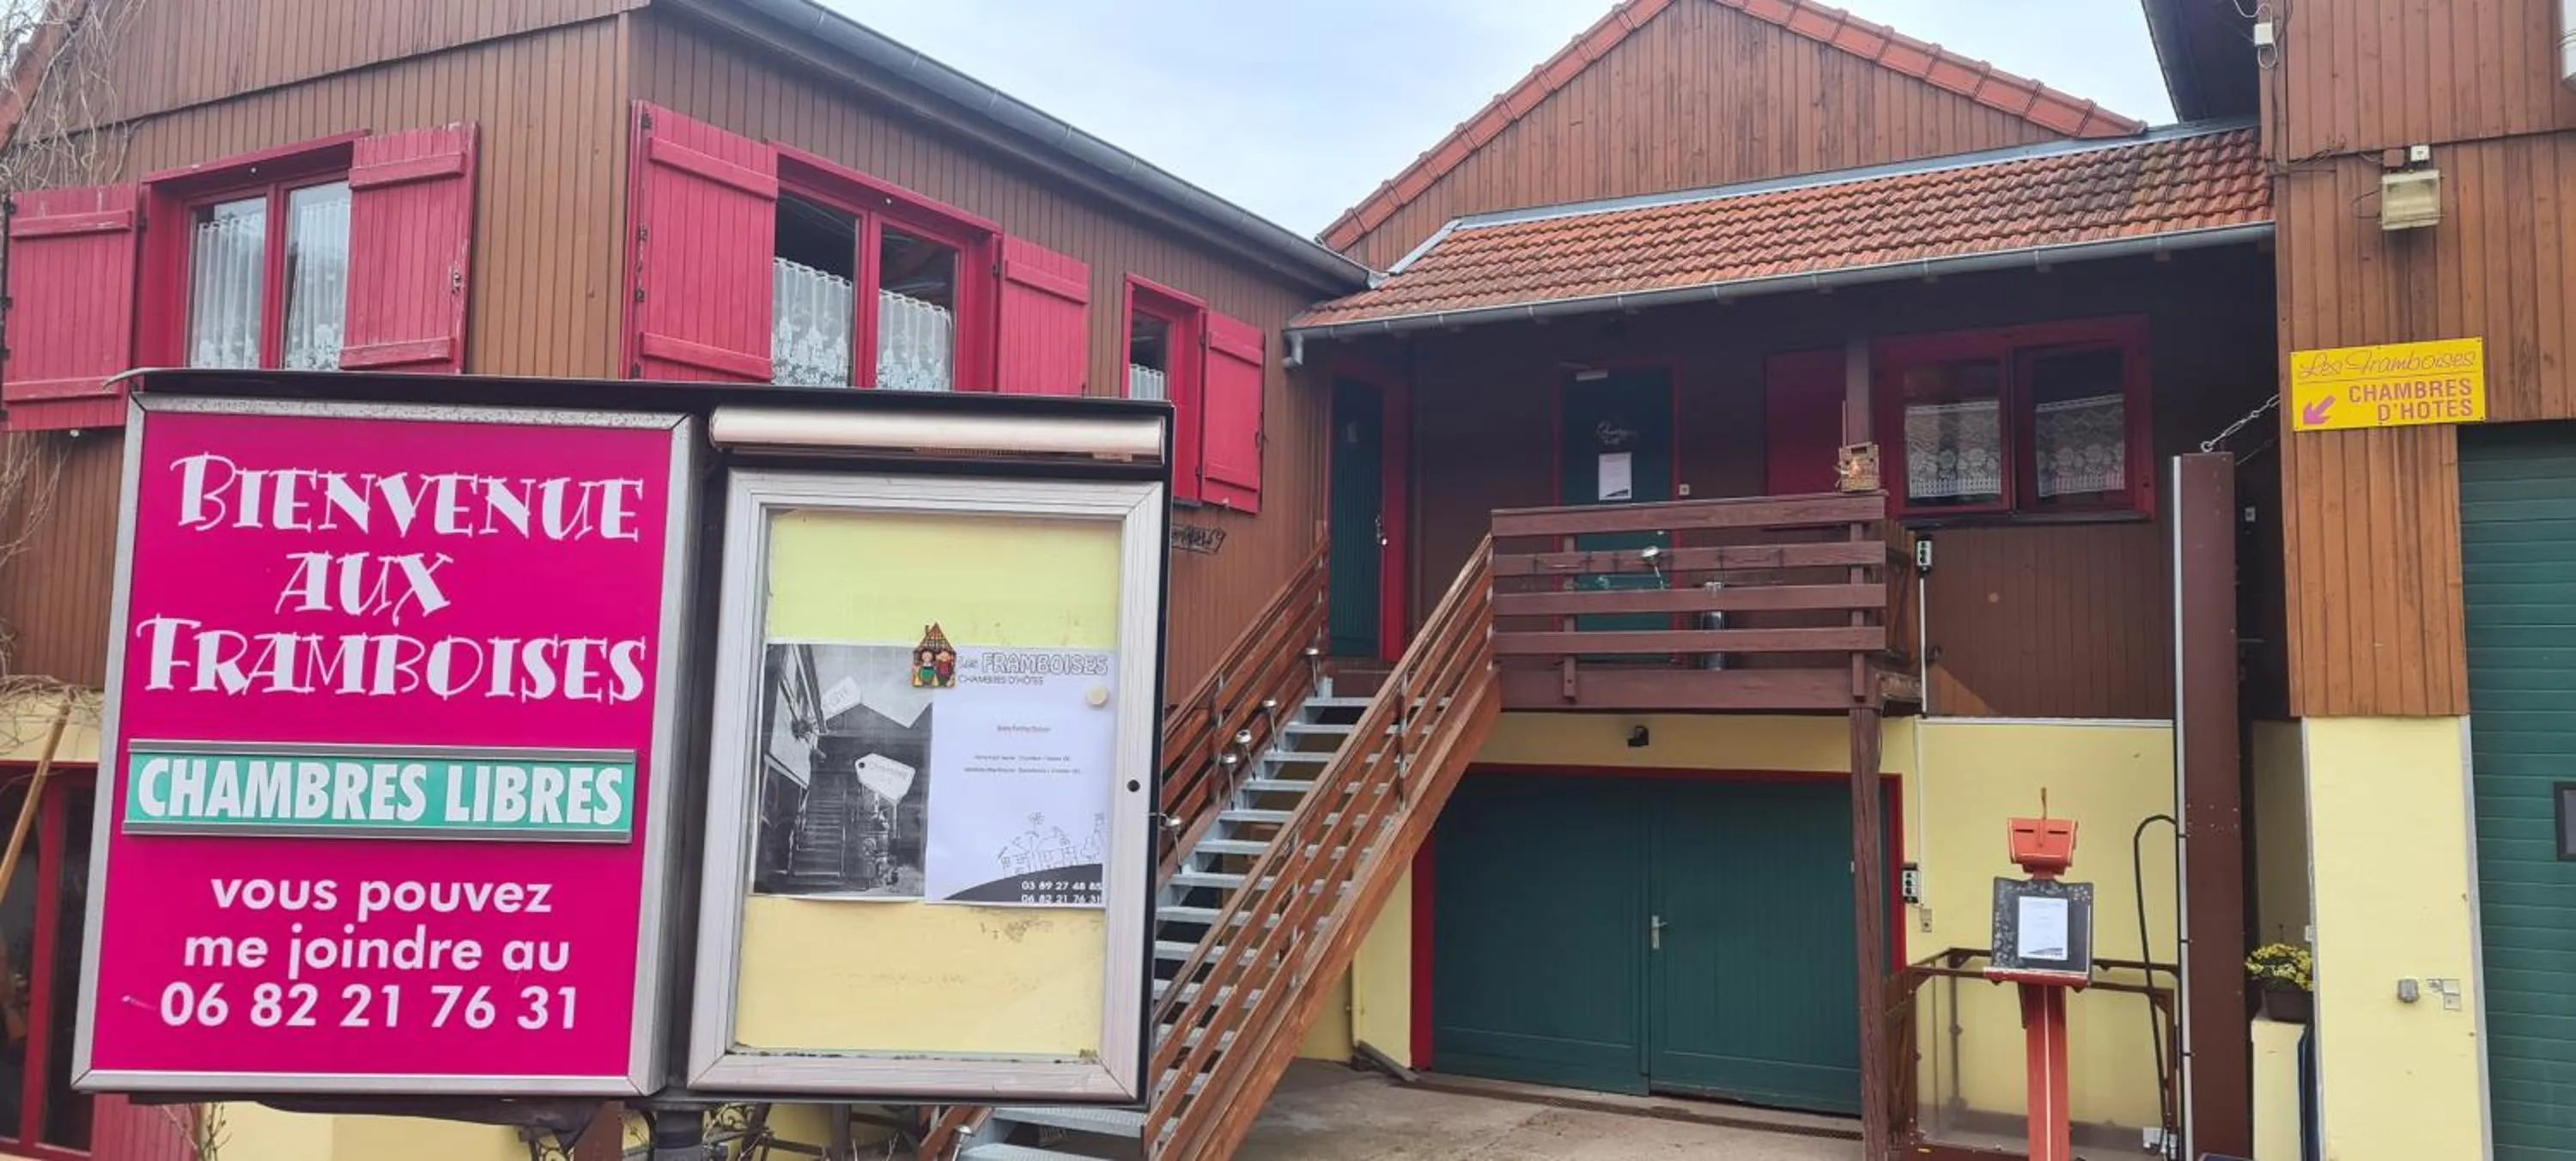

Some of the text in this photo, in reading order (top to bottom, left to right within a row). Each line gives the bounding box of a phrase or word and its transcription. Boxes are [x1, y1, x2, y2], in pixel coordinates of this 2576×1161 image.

[2348, 378, 2472, 403] CHAMBRES
[2377, 398, 2473, 422] D'HOTES
[170, 451, 644, 543] BIENVENUE
[275, 550, 453, 626] AUX
[136, 614, 647, 705] FRAMBOISES
[958, 674, 1006, 684] CHAMBRES
[982, 652, 1109, 675] FRAMBOISES
[138, 757, 623, 825] CHAMBRES LIBRES
[211, 878, 552, 922] vous pouvez
[1055, 881, 1069, 891] 27
[1055, 894, 1068, 904] 21
[184, 922, 570, 980] me joindre au
[161, 982, 577, 1030] 06 82 21 76 31
